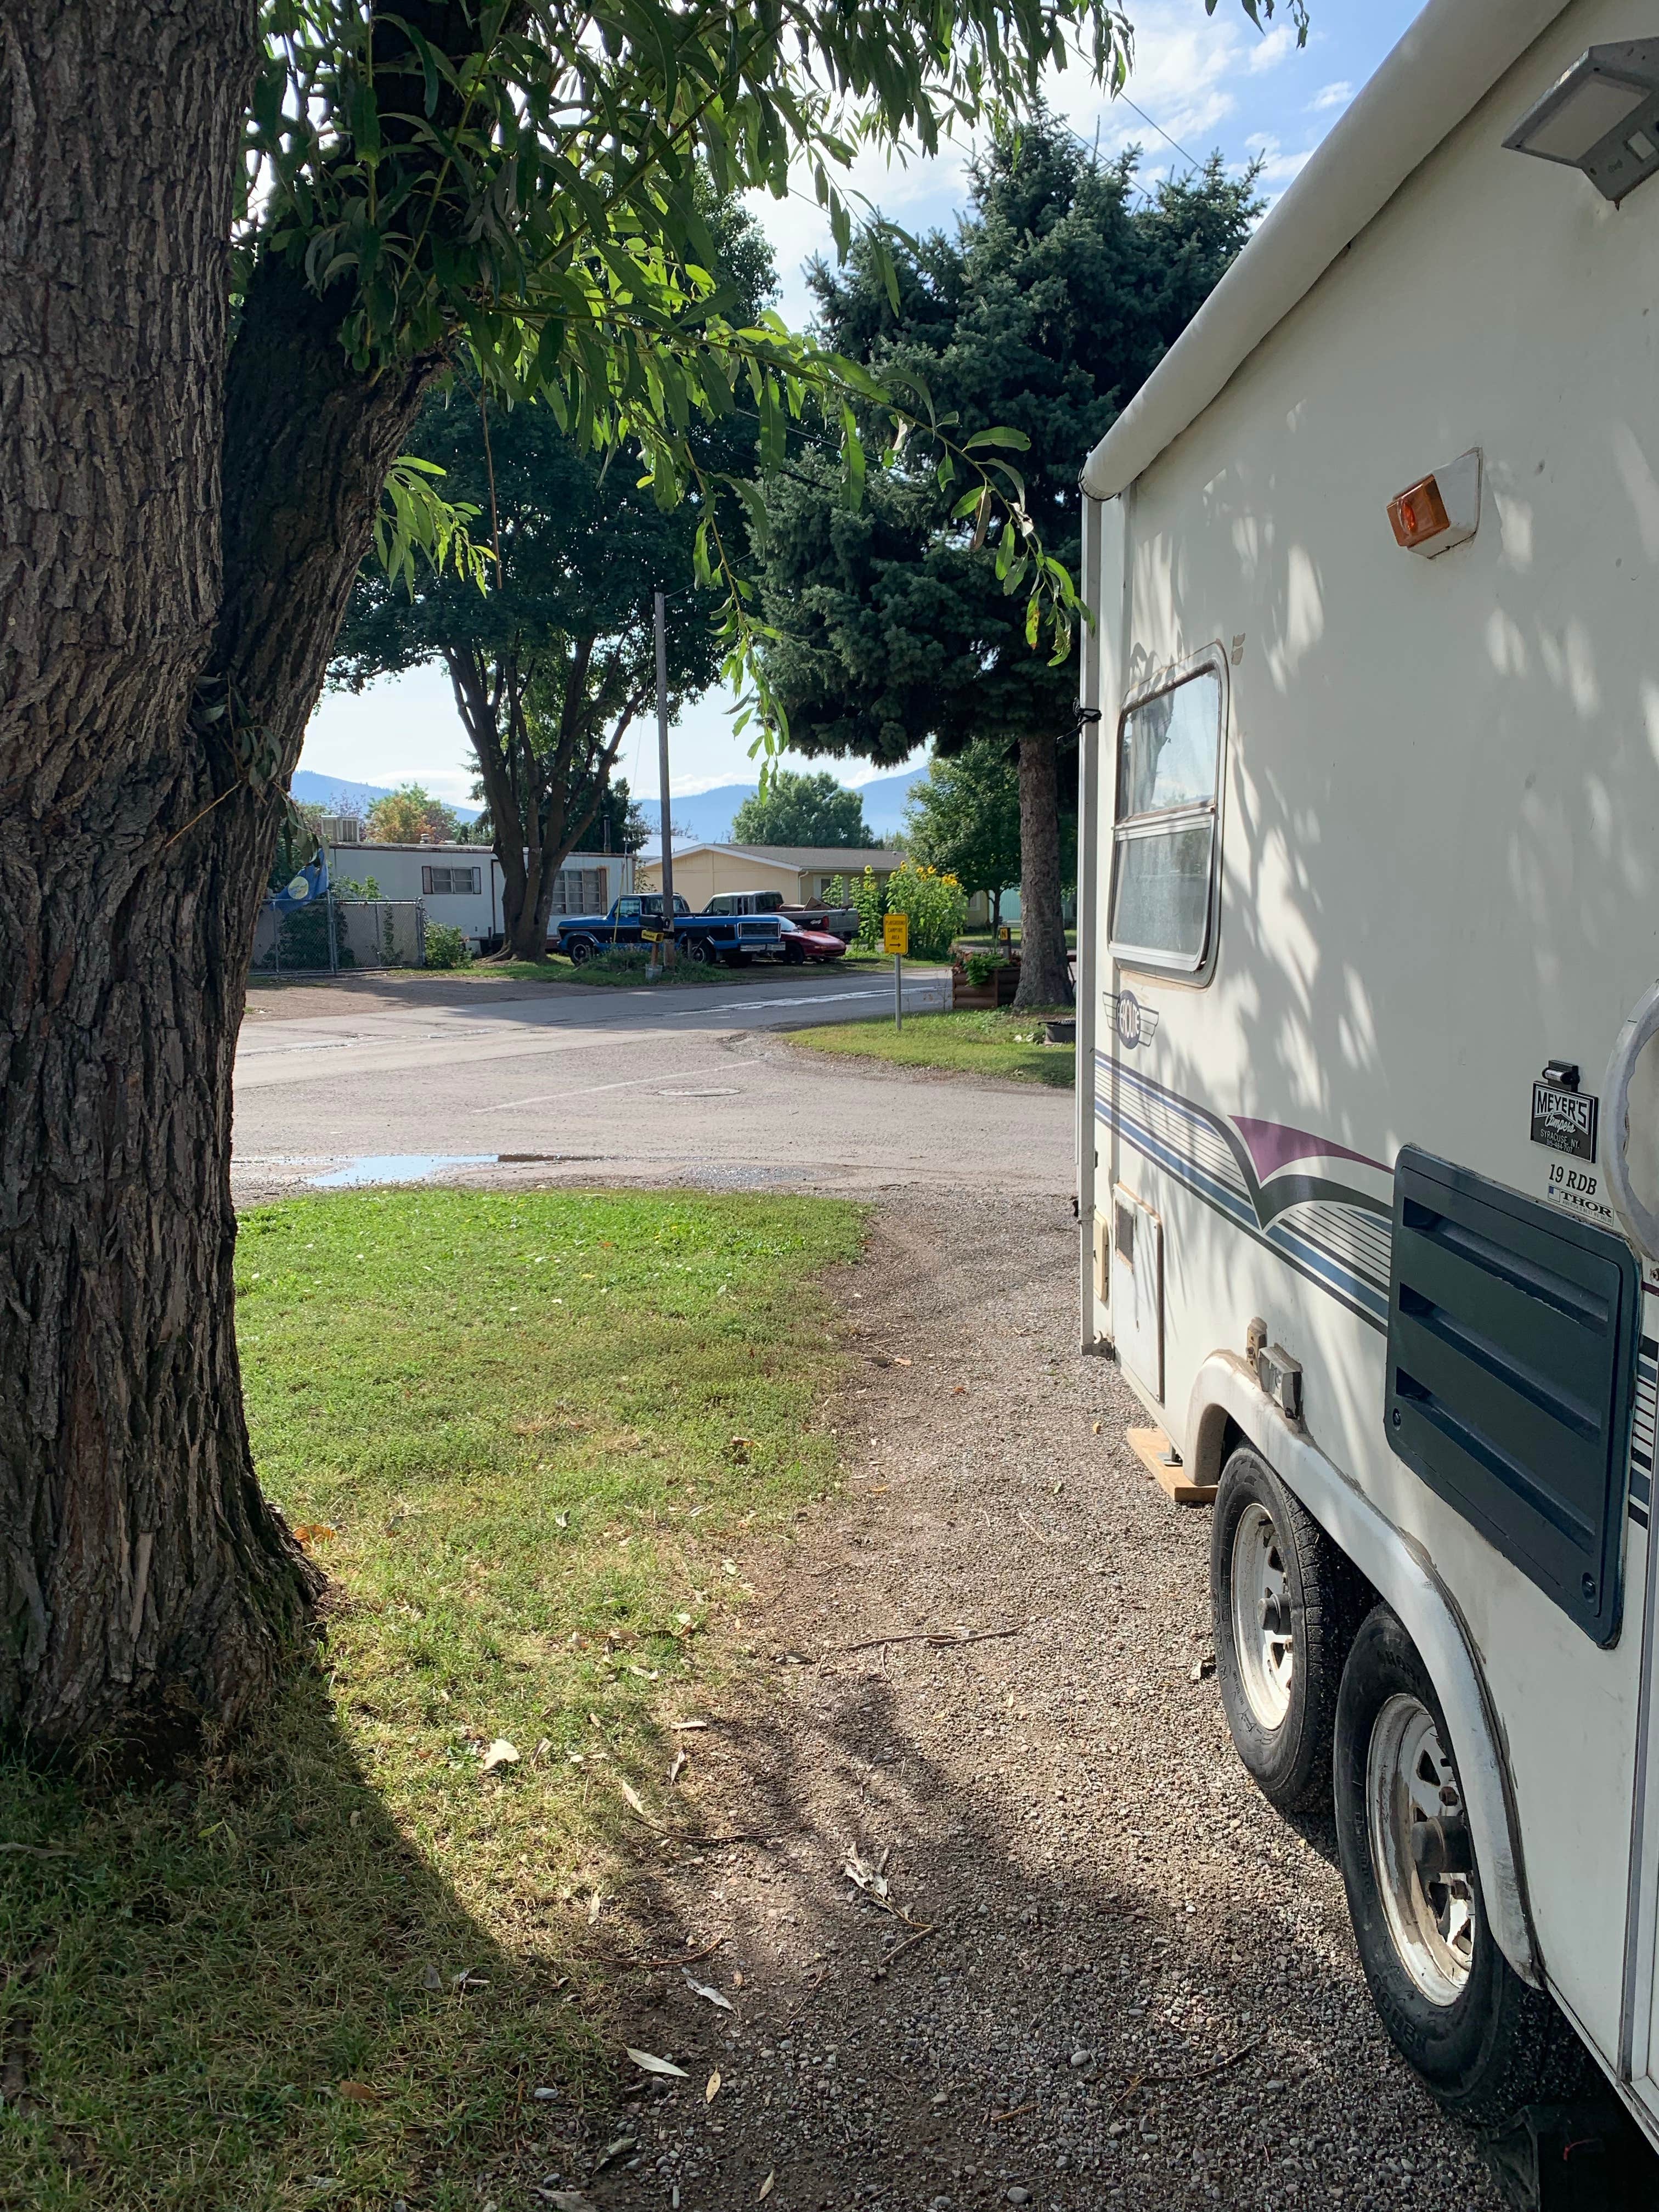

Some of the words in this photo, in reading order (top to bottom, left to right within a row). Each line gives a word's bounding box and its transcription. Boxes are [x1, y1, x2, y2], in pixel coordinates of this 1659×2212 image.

[1537, 1090, 1587, 1129] MEYER'S
[1545, 1109, 1576, 1133] Campers
[1549, 1164, 1564, 1183] 19
[1566, 1170, 1597, 1195] RDB
[1561, 1190, 1612, 1218] THOR
